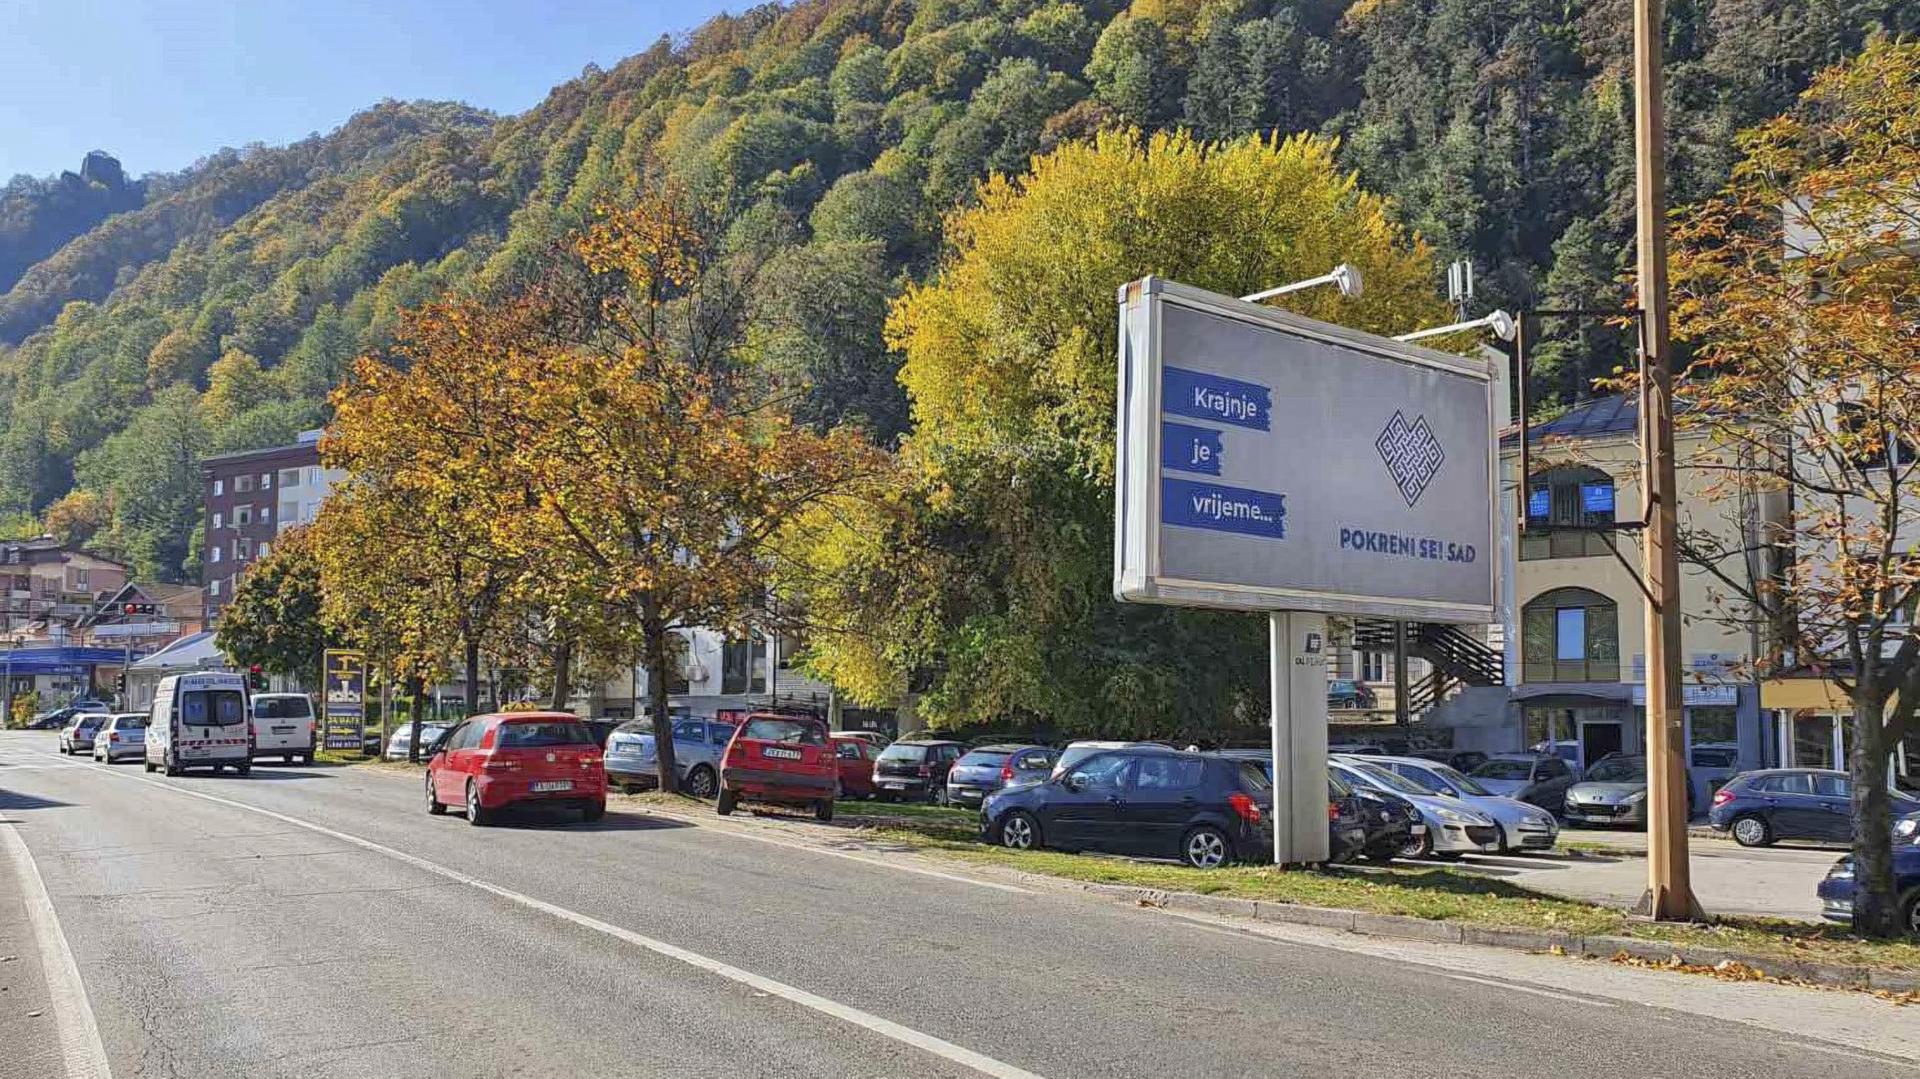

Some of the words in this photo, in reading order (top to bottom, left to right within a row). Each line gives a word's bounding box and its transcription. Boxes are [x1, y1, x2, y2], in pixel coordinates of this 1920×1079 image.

[1194, 386, 1258, 420] Krajnje
[1191, 438, 1211, 464] je
[1192, 493, 1273, 523] vrijeme...
[1340, 528, 1416, 557] POKRENI
[1447, 542, 1477, 563] SAD
